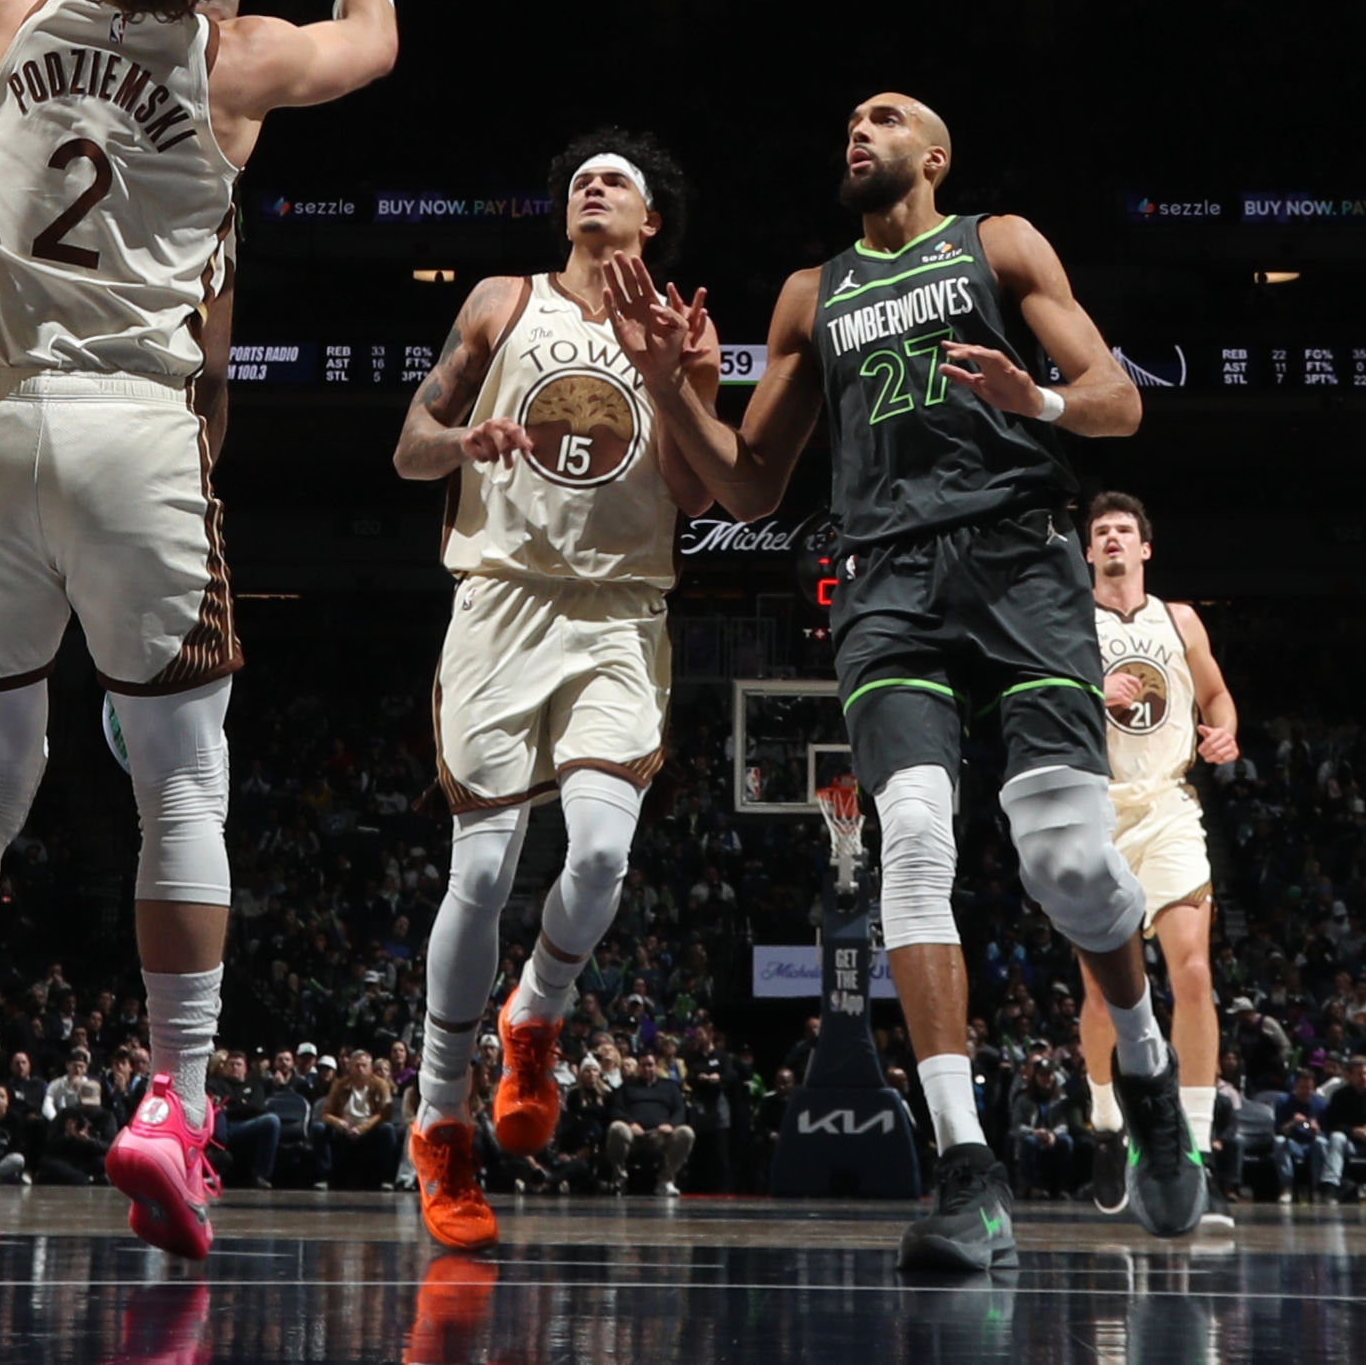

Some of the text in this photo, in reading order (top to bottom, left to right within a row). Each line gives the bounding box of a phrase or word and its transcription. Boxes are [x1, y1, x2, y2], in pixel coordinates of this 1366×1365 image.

[8, 48, 197, 153] PODZIEMSKI
[32, 138, 113, 269] 2
[294, 198, 355, 215] sezzle
[378, 199, 415, 215] BUY
[419, 199, 468, 215] NOW.
[474, 199, 506, 215] PAY
[1159, 199, 1221, 216] sezzle
[1244, 200, 1282, 216] BUY
[1286, 200, 1336, 216] NOW.
[922, 248, 962, 263] sezzle
[827, 277, 973, 357] TIMBERWOLVES
[229, 346, 299, 362] PORTS RADIO
[326, 346, 433, 357] REB 33 FG%
[1222, 348, 1366, 360] REB 22 FG% 35
[325, 358, 350, 369] AST
[405, 358, 431, 368] FT%
[721, 351, 752, 375] 59
[1223, 361, 1247, 373] AST
[1275, 362, 1286, 372] 11
[1305, 361, 1333, 372] FT%
[237, 364, 268, 380] 100.3
[326, 371, 349, 382] STL
[859, 327, 953, 425] 27
[1223, 374, 1248, 385] STL
[1304, 374, 1338, 385] 3PT%
[557, 434, 593, 476] 15
[1130, 701, 1151, 727] 21
[835, 948, 859, 968] GET
[835, 969, 859, 990] THE
